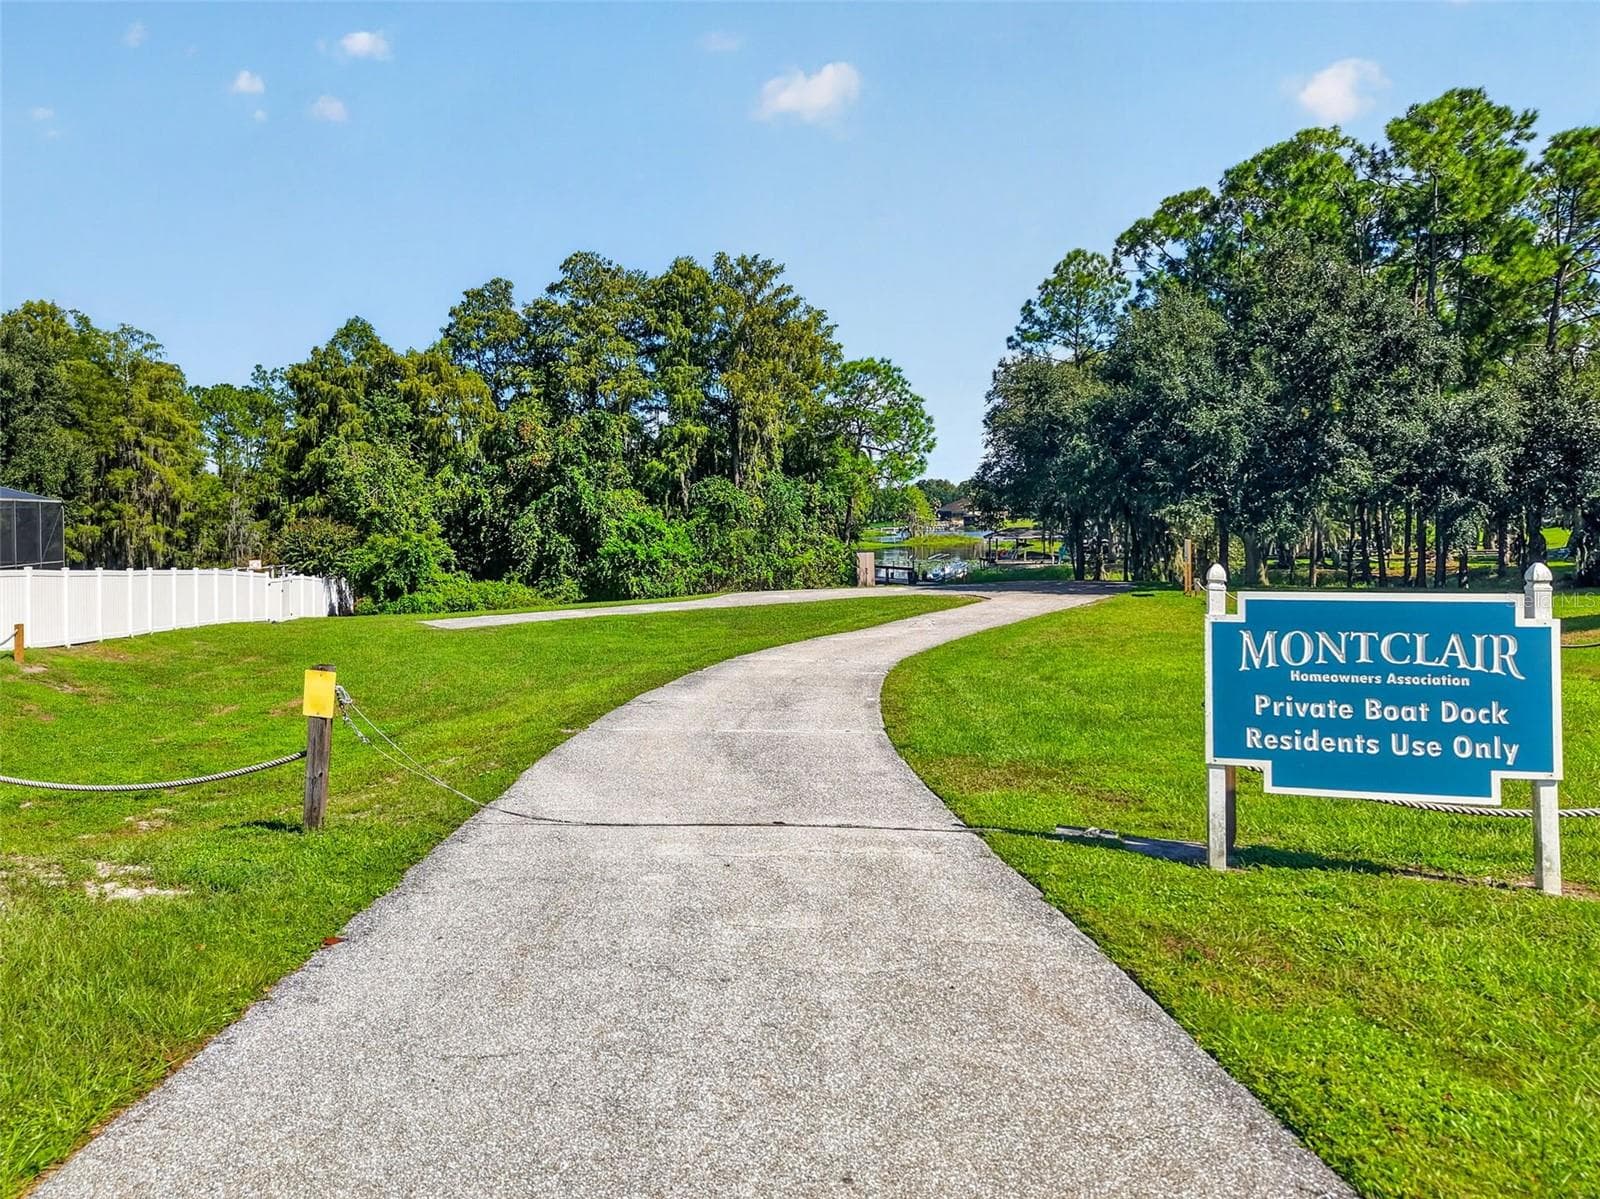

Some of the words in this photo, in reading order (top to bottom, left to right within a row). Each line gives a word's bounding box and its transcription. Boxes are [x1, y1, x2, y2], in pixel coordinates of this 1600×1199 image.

[1239, 630, 1525, 680] MONTCLAIR
[1290, 670, 1382, 684] Homeowners
[1386, 672, 1470, 687] Association
[1254, 694, 1354, 720] Private
[1365, 698, 1430, 723] Boat
[1441, 700, 1510, 725] Dock
[1245, 727, 1380, 756] Residents
[1391, 733, 1442, 758] Use
[1452, 735, 1520, 766] Only
